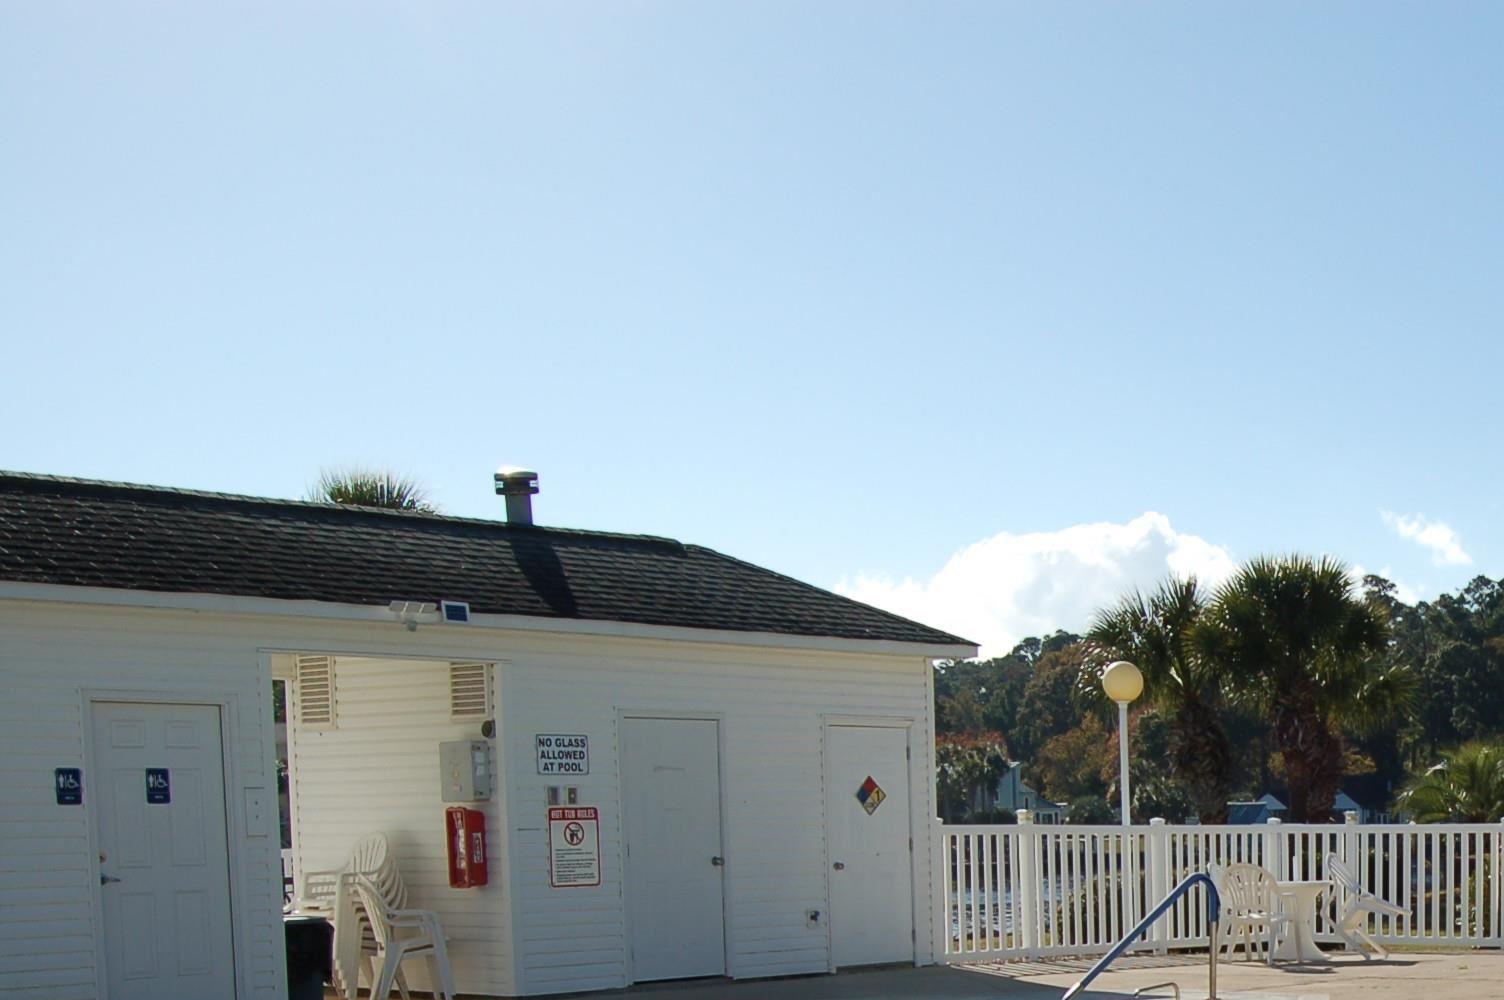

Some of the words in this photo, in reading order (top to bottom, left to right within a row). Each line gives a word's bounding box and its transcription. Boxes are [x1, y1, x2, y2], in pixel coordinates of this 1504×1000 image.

[538, 738, 552, 748] NO
[555, 738, 586, 748] GLASS
[540, 750, 585, 760] ALLOWED
[543, 763, 554, 772] AT
[558, 762, 584, 772] POOL
